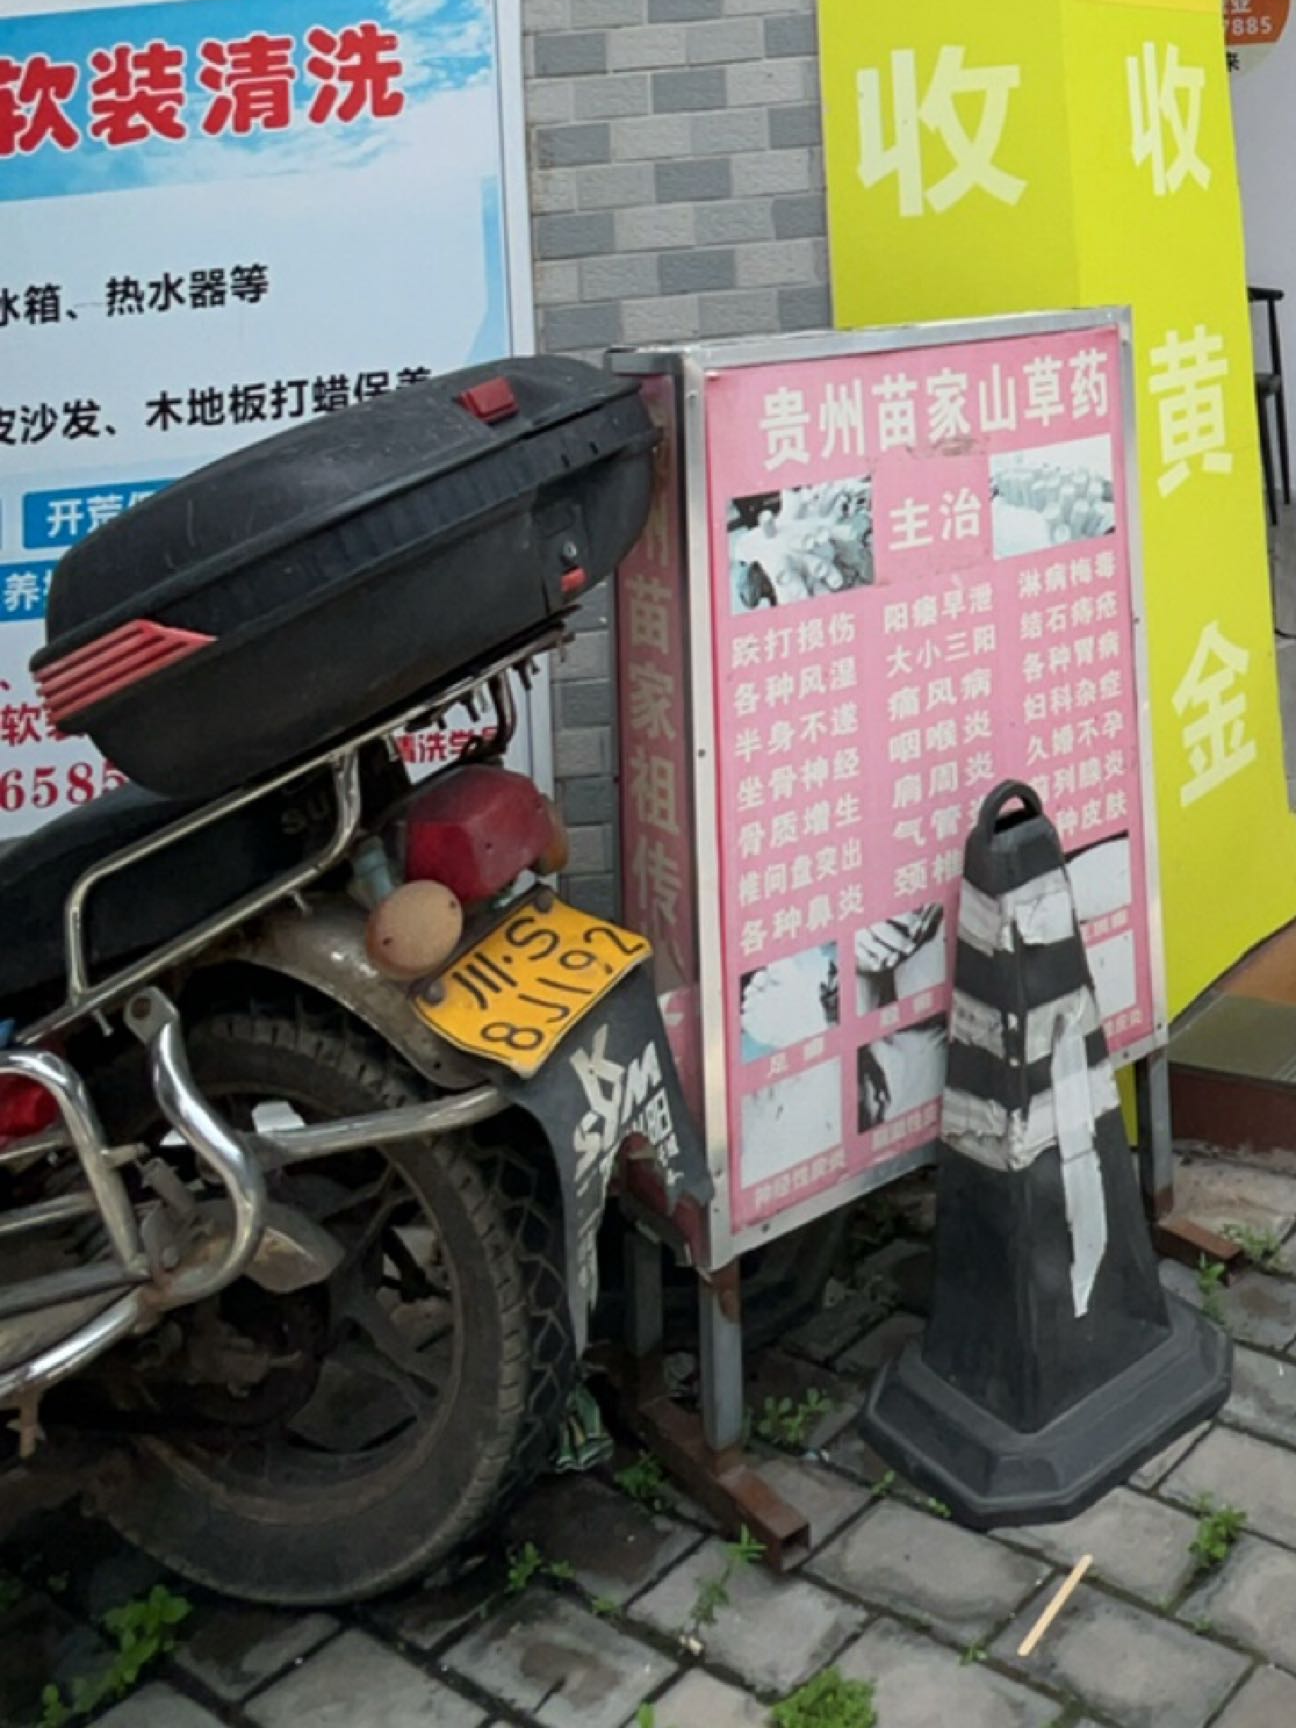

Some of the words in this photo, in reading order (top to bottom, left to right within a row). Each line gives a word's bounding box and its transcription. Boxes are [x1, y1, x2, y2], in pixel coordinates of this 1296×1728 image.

[0, 21, 406, 158] 软装清洗
[758, 348, 1110, 472] 贵州苗家山草药
[46, 491, 158, 539] 开荒
[887, 487, 982, 552] 主治
